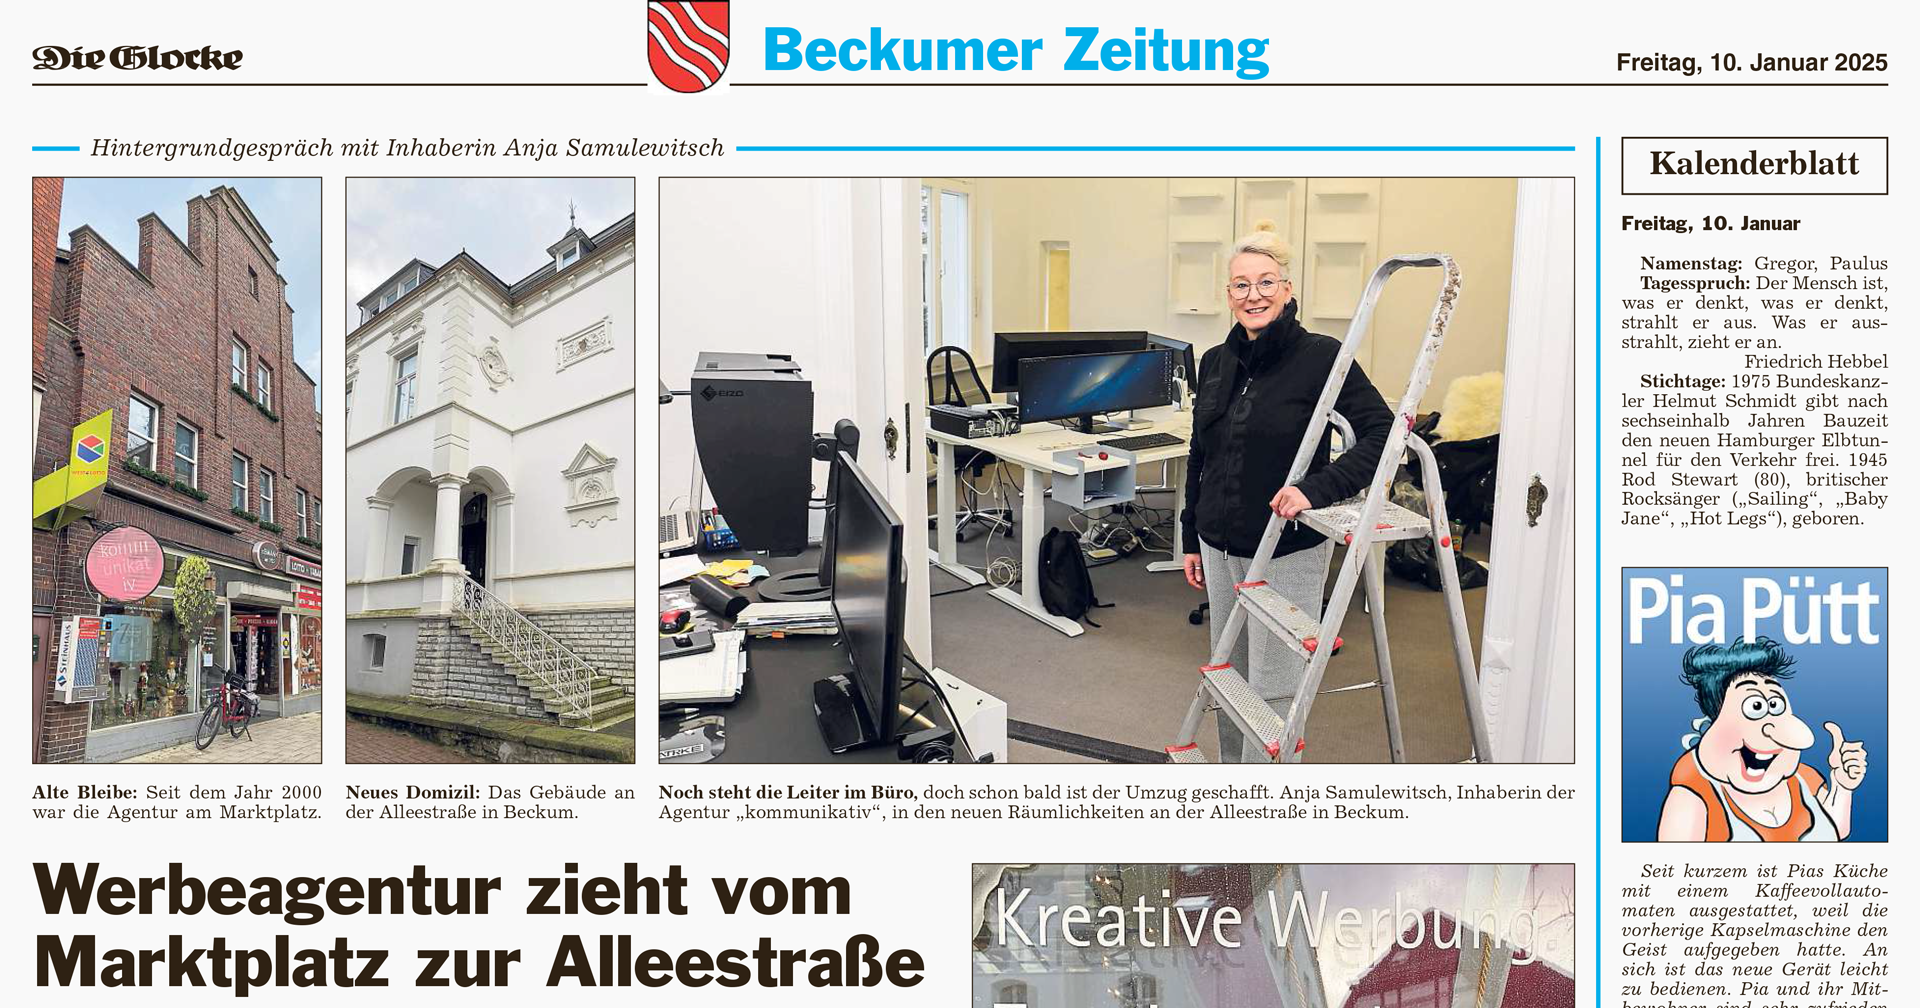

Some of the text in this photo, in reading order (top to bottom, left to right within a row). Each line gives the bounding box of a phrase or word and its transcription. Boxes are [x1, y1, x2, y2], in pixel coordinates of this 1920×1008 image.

[32, 45, 243, 70] Die Glocke
[765, 27, 1269, 80] Beckumer Zeitung
[1618, 53, 1887, 76] Freitag, 10. Januar 2025
[91, 138, 724, 161] Hintergrundgespräch mit Inhaberin Anja Samulewitsch
[1650, 150, 1859, 175] Kalenderblatt
[1623, 216, 1800, 234] Freitag, 10. Januar
[1641, 256, 1887, 273] Namenstag: Gregor, Paulus
[1641, 275, 1887, 293] Tagesspruch: Der Mensch ist,
[1622, 334, 1781, 351] strahlt, zieht er an.
[1745, 354, 1888, 368] Friedrich Hebbel
[1641, 374, 1725, 391] Stichtage:
[1733, 374, 1770, 388] 1975
[1622, 393, 1888, 411] ler Helmut Schmidt gibt nach
[1622, 413, 1888, 427] sechseinhalb Jahren Bauzeit
[1622, 452, 1887, 466] nel für den Verkehr frei. 1945
[1622, 472, 1654, 486] Rod
[1672, 473, 1738, 486] Stewart
[1806, 472, 1888, 486] britischer
[1622, 491, 1720, 509] Rocksänger
[1792, 511, 1863, 528] geboren.
[104, 556, 151, 576] unikat
[1630, 574, 1880, 645] Pia Pütt
[32, 785, 321, 799] Alte Bleibe: Seit dem Jahr 2000
[346, 785, 634, 799] Neues Domizil: Das Gebäude an
[659, 785, 1575, 803] Noch steht die Leiter im Büro, doch schon bald ist der Umzug geschafft. Anja Samulewitsch, Inhaberin der
[33, 804, 321, 822] war die Agentur am Marktplatz.
[346, 804, 577, 818] der Alleestraße in Beckum.
[659, 805, 730, 822] Agentur
[893, 805, 908, 818] in
[915, 804, 945, 818] den
[951, 809, 1002, 818] neuen
[1008, 804, 1144, 818] Räumlichkeiten
[1150, 809, 1170, 818] an
[1176, 804, 1204, 818] der
[1210, 804, 1306, 818] Alleestraße
[1313, 805, 1329, 818] in
[1335, 804, 1408, 818] Beckum.
[1641, 864, 1887, 877] Seit kurzem ist Pias Küche
[33, 863, 850, 925] Werbeagentur zieht vom
[1622, 884, 1651, 897] mit
[1678, 884, 1728, 897] einem
[997, 887, 1242, 948] Kreative
[1622, 903, 1888, 920] maten ausgestattet, weil die
[1622, 922, 1887, 940] vorherige Kapselmaschine den
[1623, 942, 1887, 960] Geist aufgegeben hatte. An
[37, 934, 924, 997] Marktplatz zur Alleestraße
[1622, 986, 1641, 995] zu
[1651, 981, 1730, 995] bedienen.
[1740, 982, 1768, 995] Pia
[1777, 981, 1810, 995] und
[1818, 981, 1843, 995] ihr
